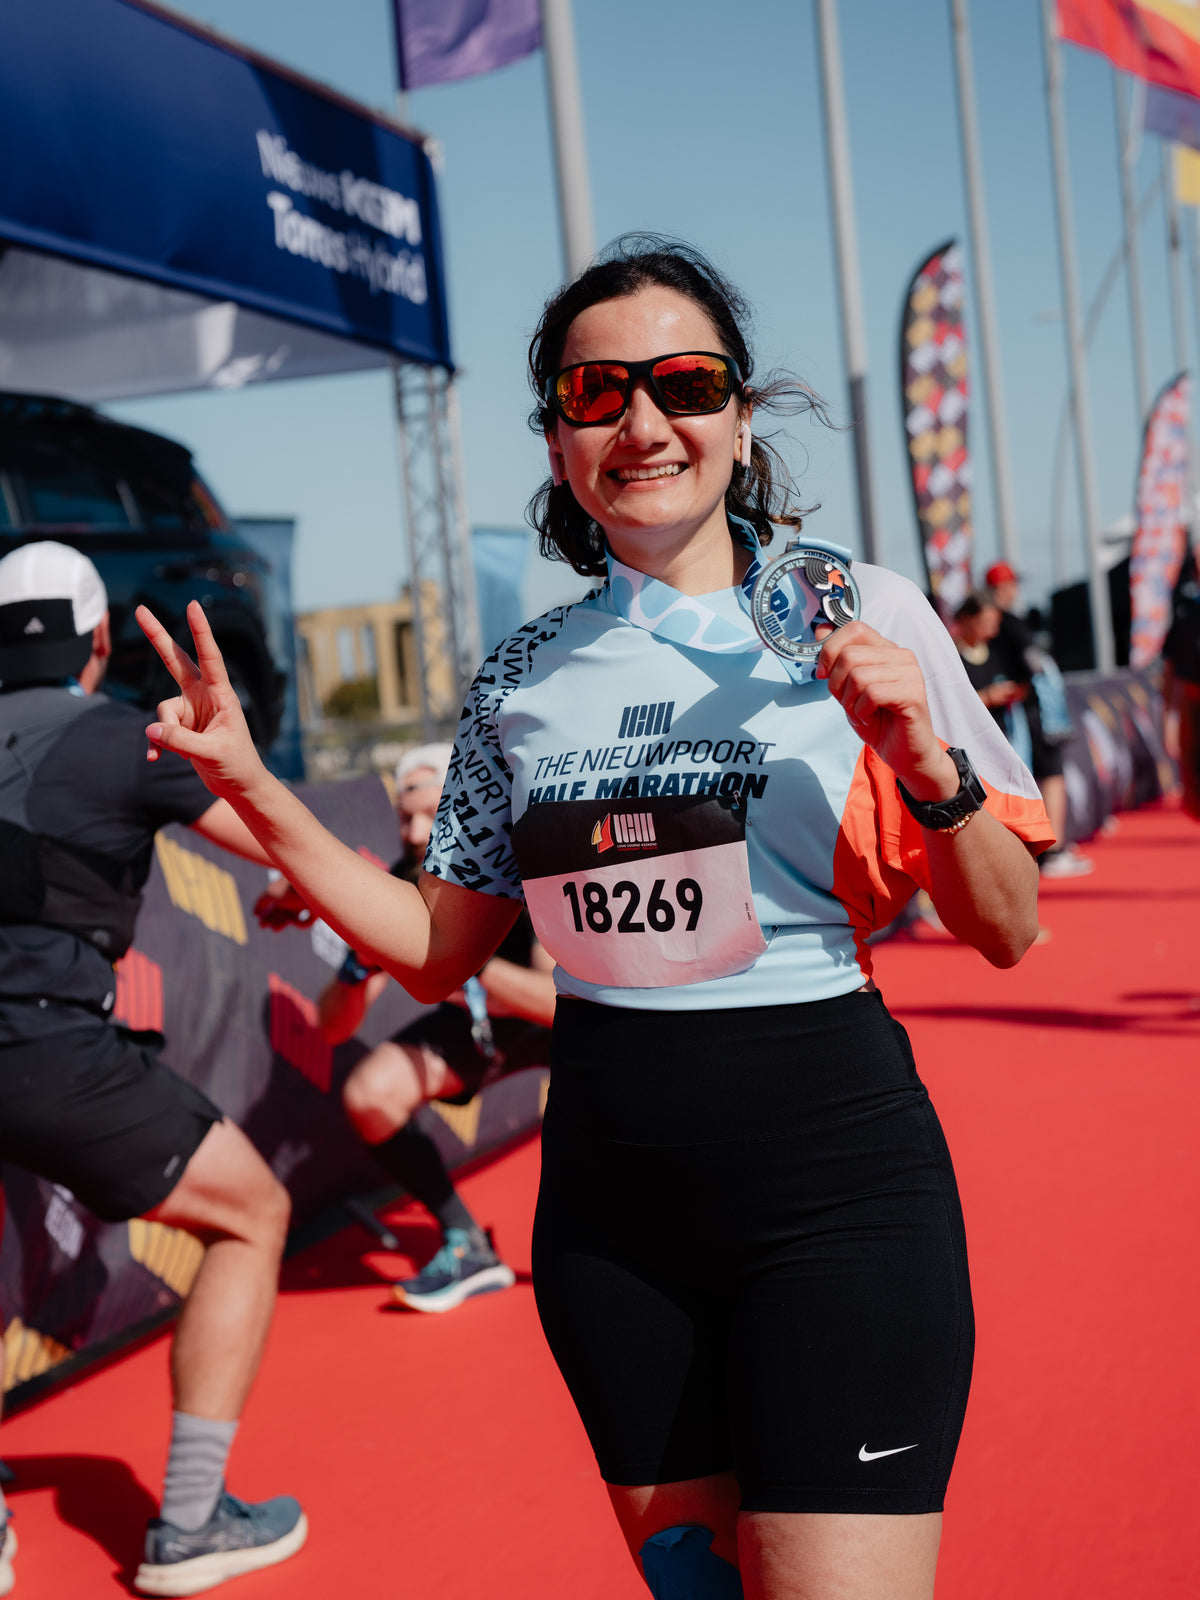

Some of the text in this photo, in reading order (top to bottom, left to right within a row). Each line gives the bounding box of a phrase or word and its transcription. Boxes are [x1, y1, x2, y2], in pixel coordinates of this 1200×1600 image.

[267, 191, 349, 273] Torres
[528, 772, 768, 804] HALF MARATHON
[534, 740, 776, 780] THE NIEUWPOORT
[453, 790, 495, 848] 21.1
[563, 877, 703, 933] 18269
